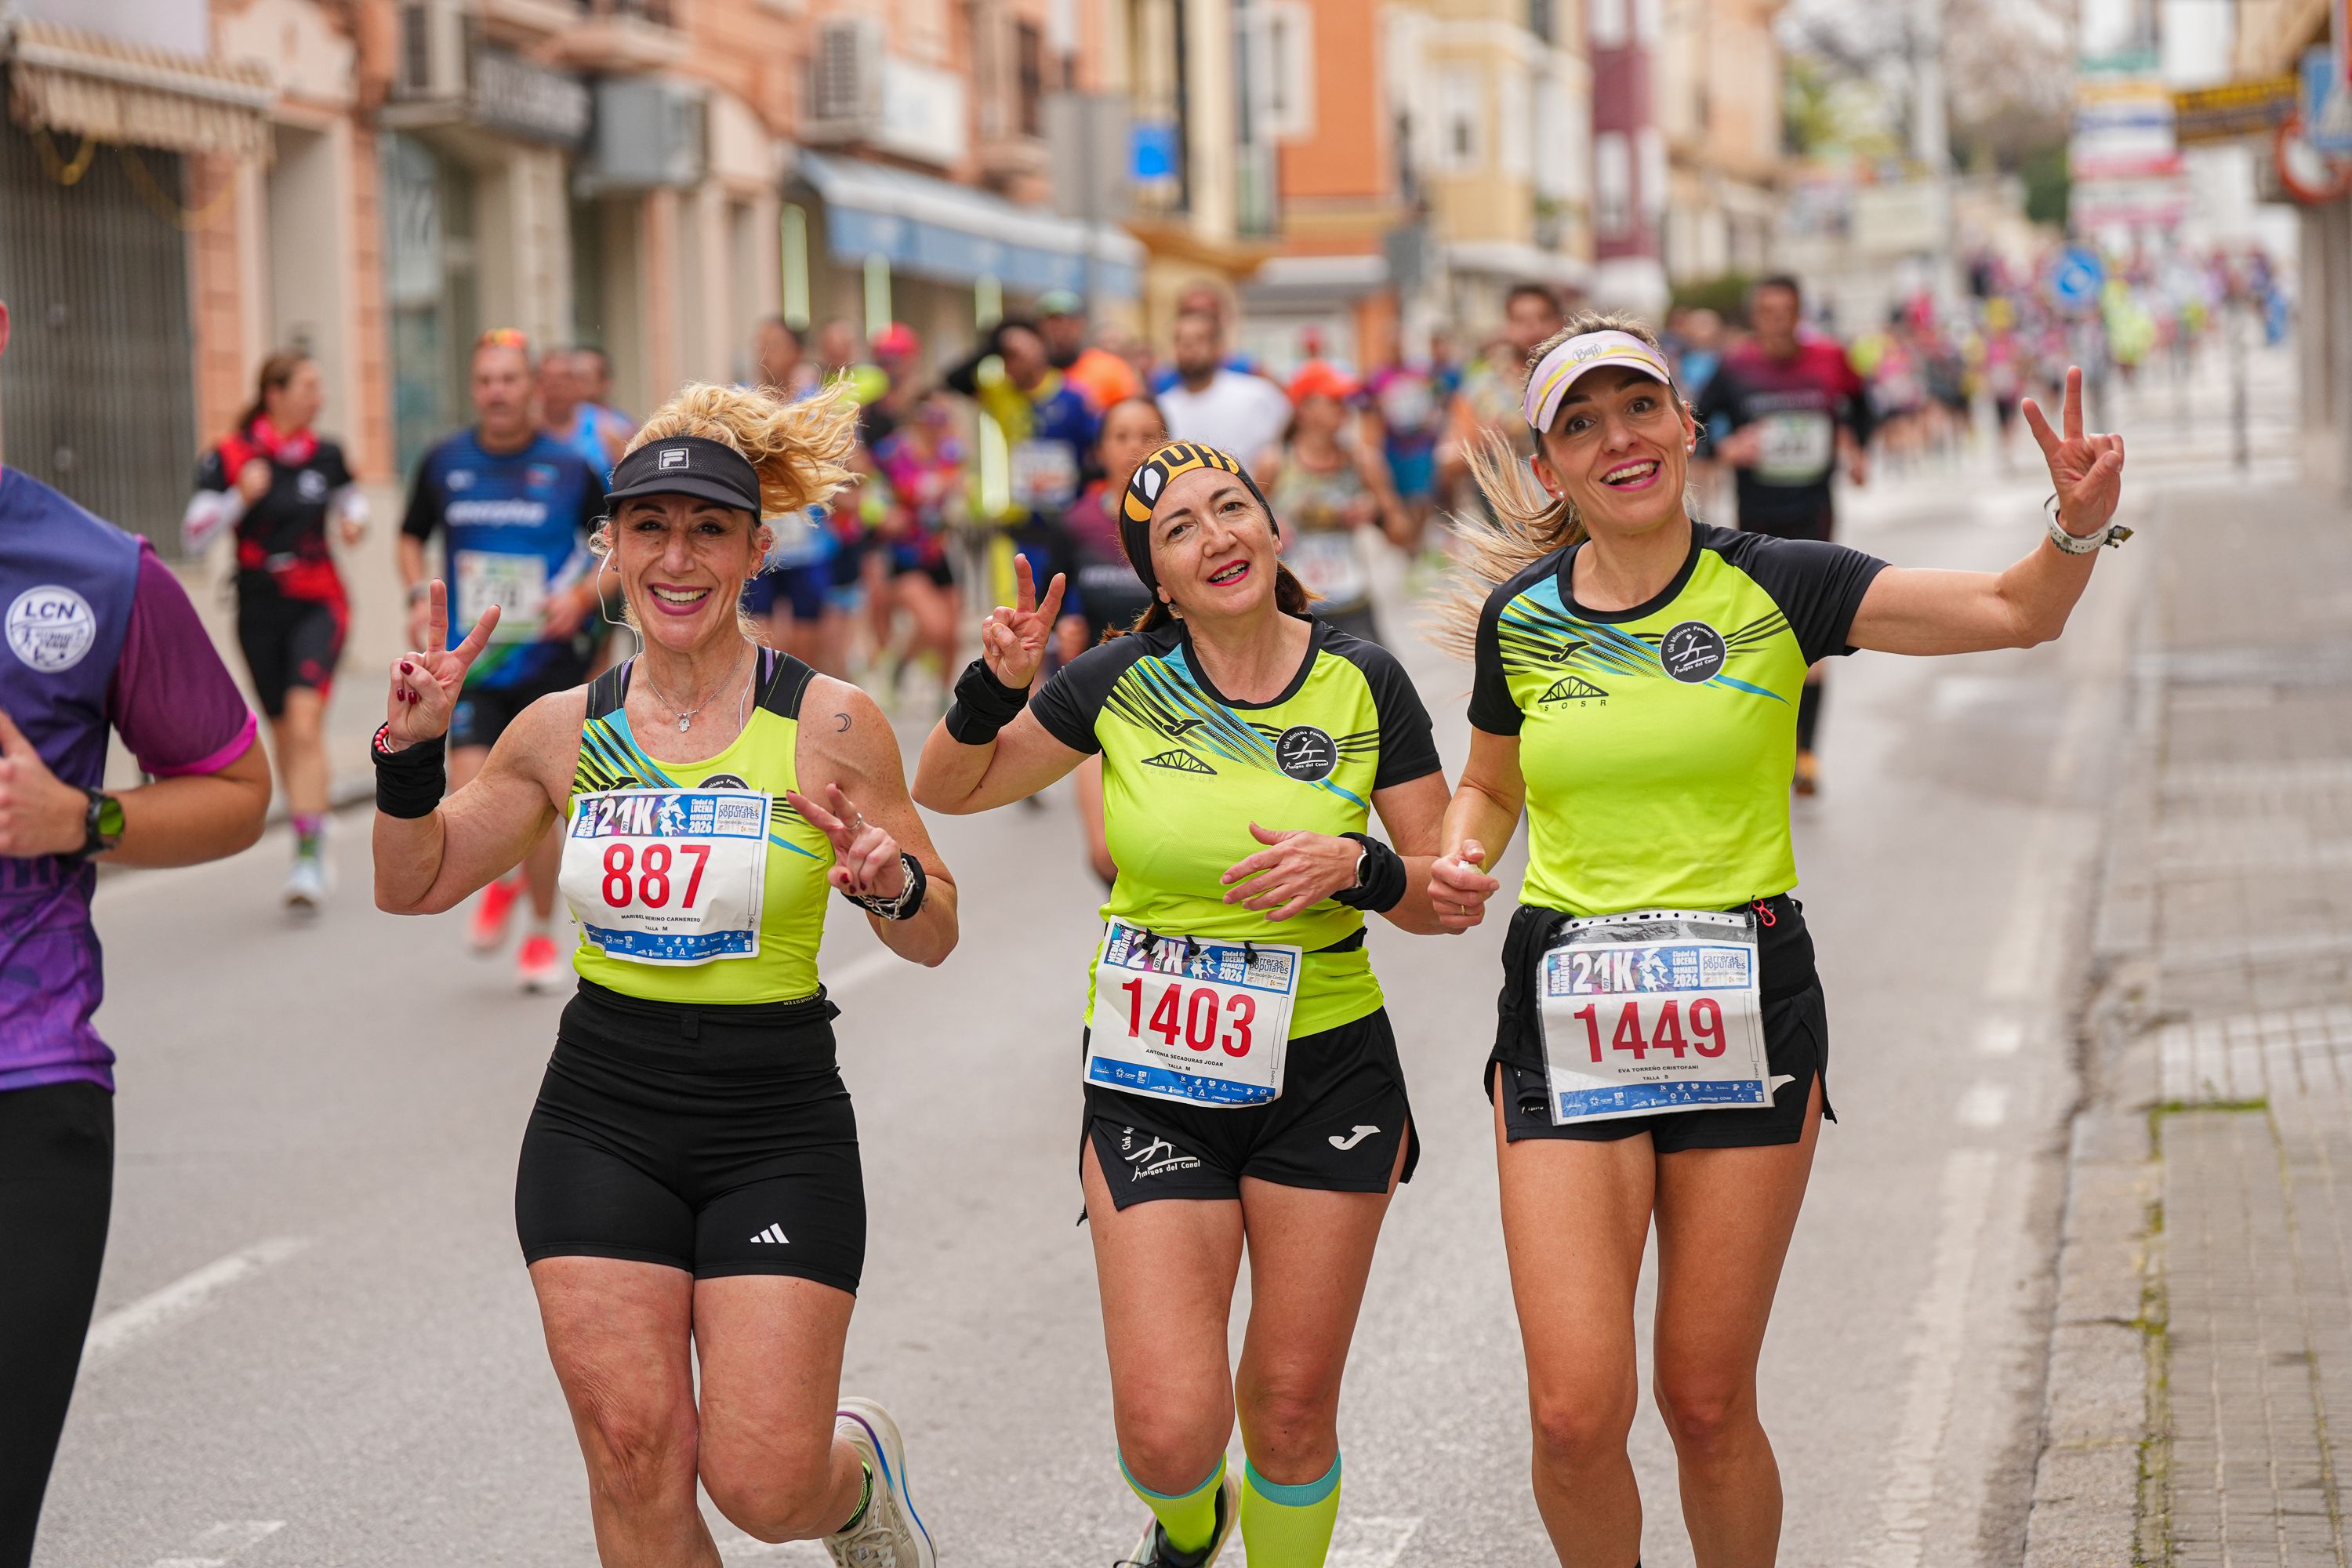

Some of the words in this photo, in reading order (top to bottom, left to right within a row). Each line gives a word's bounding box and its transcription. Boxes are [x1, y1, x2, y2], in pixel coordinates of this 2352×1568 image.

[25, 601, 75, 619] LCN
[1704, 655, 1719, 664] Canal
[691, 804, 713, 813] LUCENA
[718, 811, 759, 819] populares
[719, 804, 753, 813] carreras
[595, 797, 656, 836] 21K
[688, 821, 712, 833] 2026
[602, 843, 711, 909] 887
[1108, 940, 1120, 962] MEDIA
[1115, 929, 1134, 965] MARATÓN
[1127, 934, 1186, 974] 21K
[1249, 962, 1289, 975] populares
[1254, 957, 1283, 967] arreras
[1673, 956, 1697, 966] LUCENA
[1703, 961, 1746, 971] populares
[1218, 967, 1242, 982] 2026
[1559, 955, 1570, 993] MARATÓN
[1573, 951, 1636, 993] 21K
[1551, 969, 1560, 994] MEDIA
[1674, 974, 1698, 987] 2026
[1122, 978, 1256, 1058] 1403
[1574, 998, 1726, 1062] 1449
[1146, 1049, 1169, 1058] ANTONIA
[1171, 1054, 1203, 1064] SECADURAS
[1121, 1137, 1131, 1150] Club
[1181, 1160, 1200, 1169] Canal
